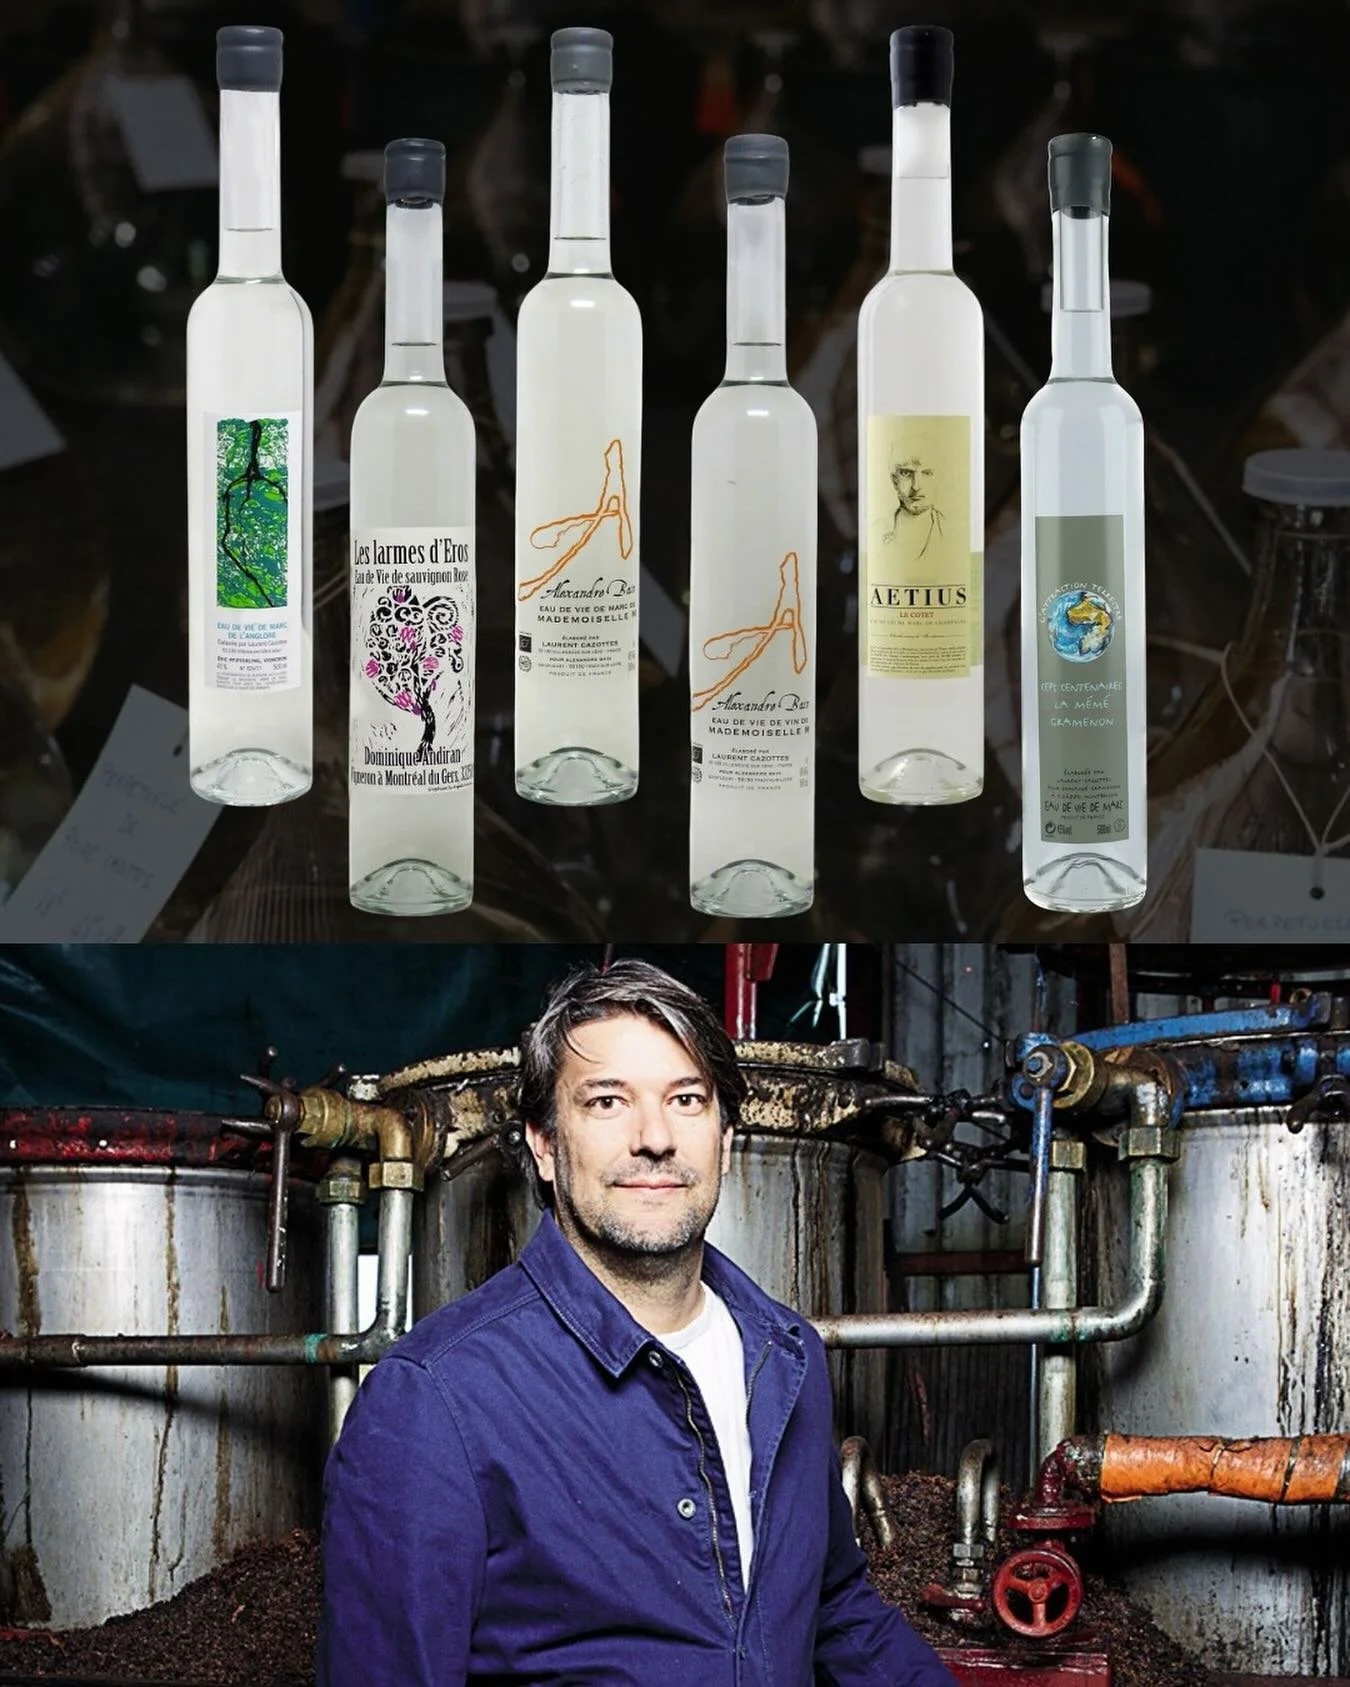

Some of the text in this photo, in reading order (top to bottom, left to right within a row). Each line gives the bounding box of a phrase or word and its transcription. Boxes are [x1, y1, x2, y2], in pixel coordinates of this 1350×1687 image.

[354, 538, 469, 565] Les larmes d'Eros
[376, 569, 390, 584] Vie
[391, 569, 403, 584] de
[405, 568, 452, 586] sauvignon
[540, 577, 605, 600] Alexandre
[871, 587, 967, 606] AETIUS
[539, 605, 556, 613] EAU
[593, 605, 606, 613] DE
[608, 603, 628, 612] MARC
[537, 612, 629, 624] MADEMOISELLE
[542, 640, 578, 649] LAURENT
[712, 690, 776, 712] Alexandre
[1054, 694, 1110, 710] LA MÉMÉ
[711, 717, 729, 725] EAU
[749, 719, 765, 727] VIE
[769, 719, 782, 727] DE
[784, 718, 800, 726] VIN
[708, 726, 802, 737] MADEMOISELLE
[364, 746, 461, 769] Dominique Andiran
[712, 753, 749, 761] LAURENT
[384, 769, 426, 786] Montréal
[428, 768, 440, 785] du
[1045, 801, 1060, 812] EAU
[1062, 801, 1072, 813] DE
[1074, 801, 1086, 813] VIE
[1089, 801, 1100, 812] DE
